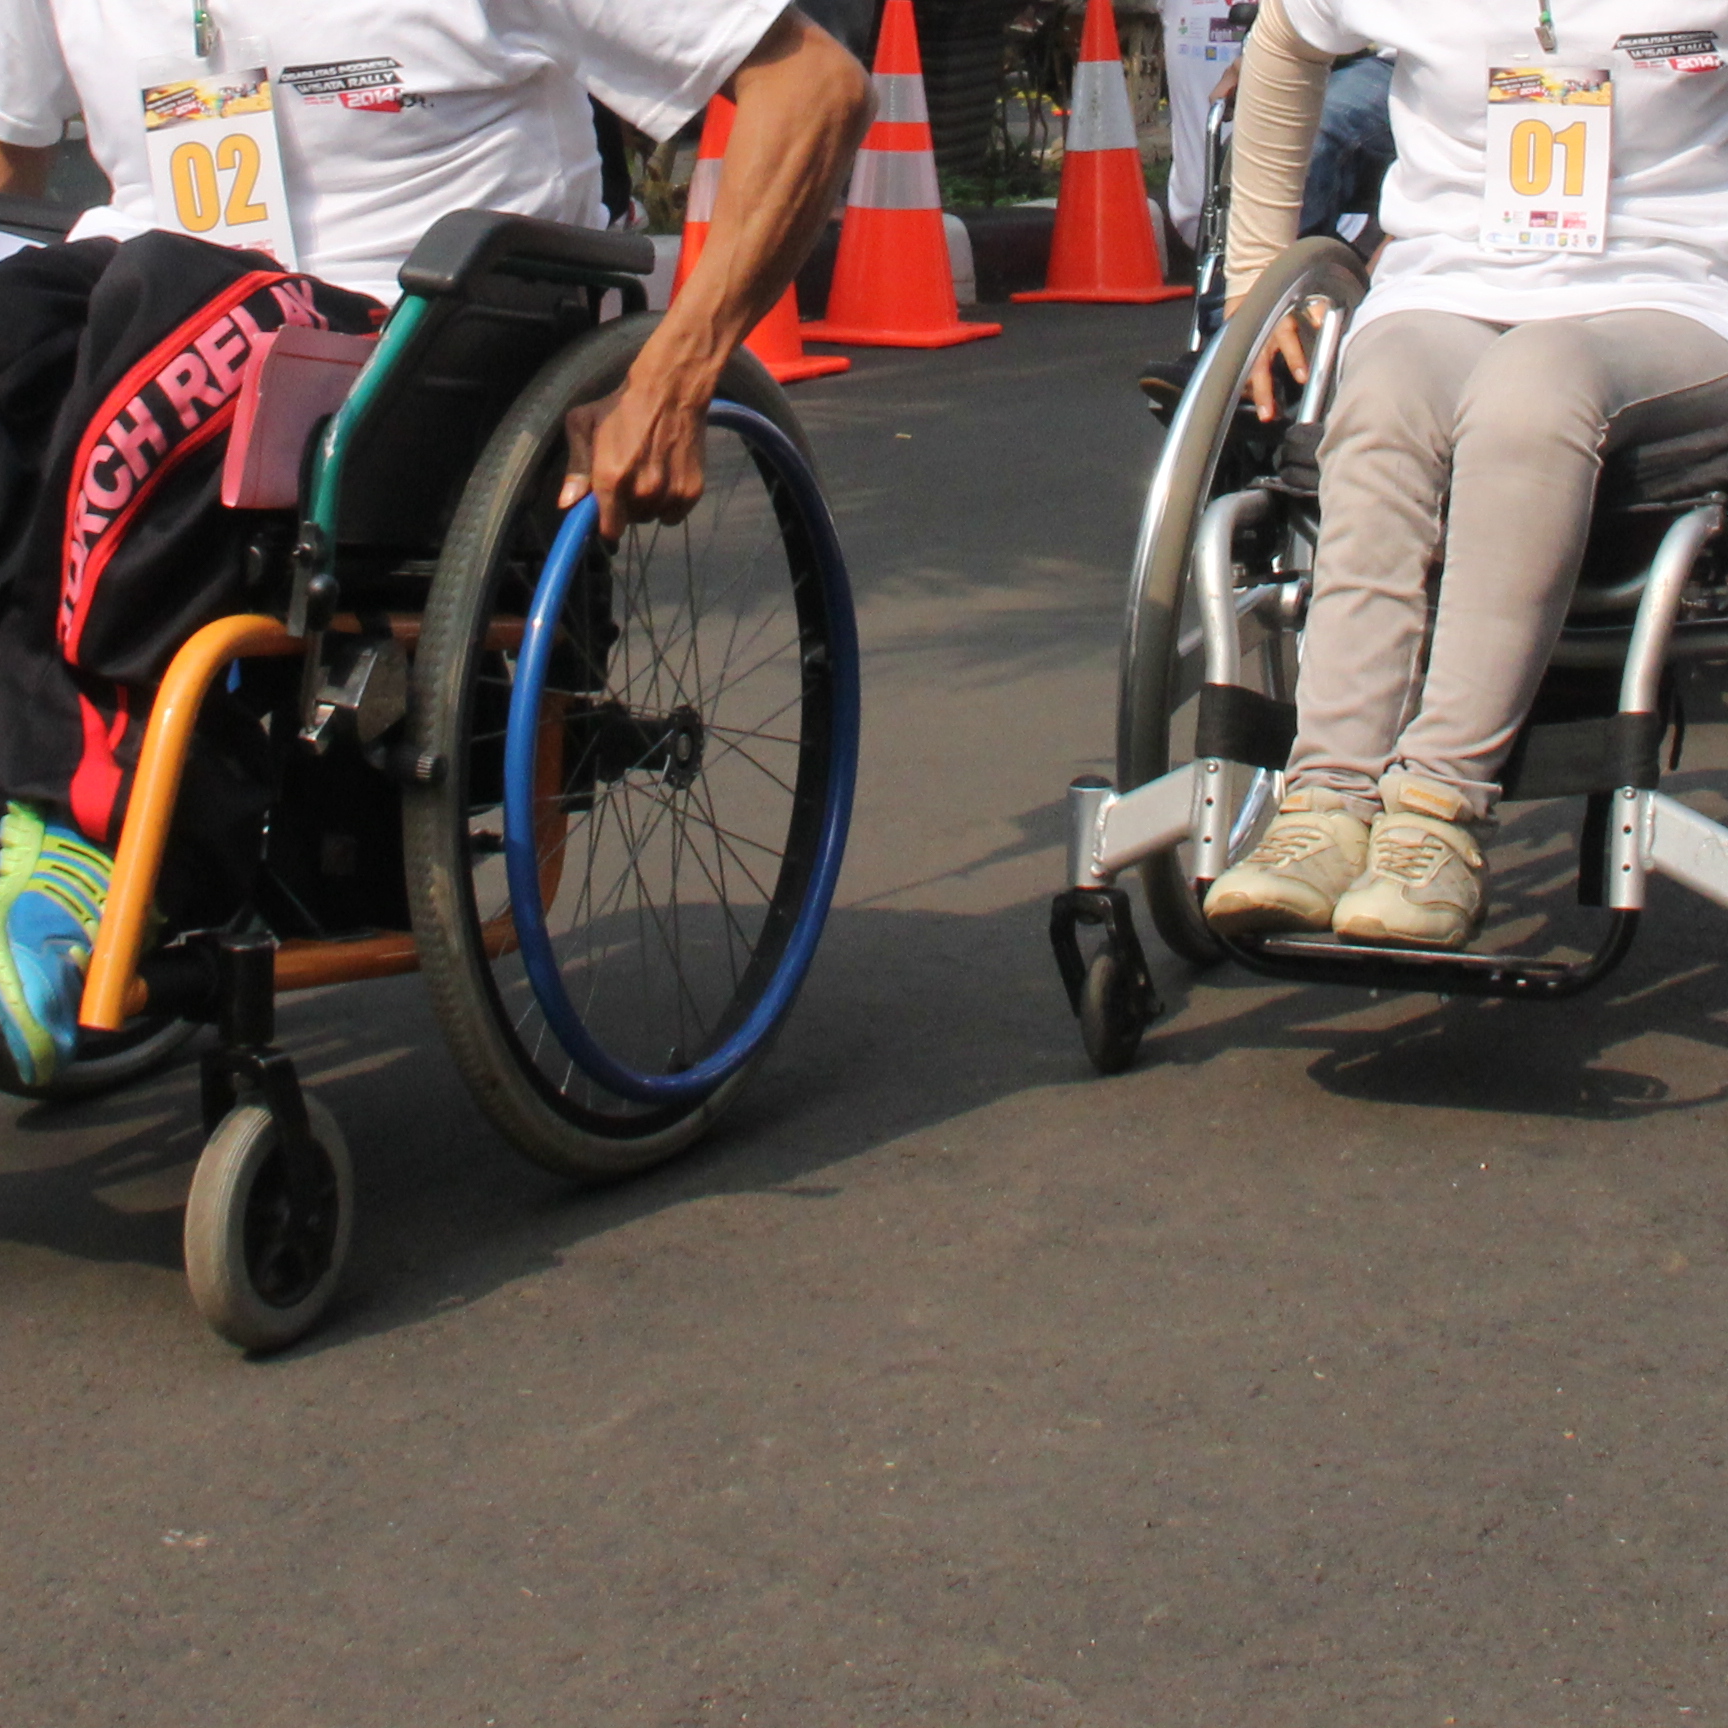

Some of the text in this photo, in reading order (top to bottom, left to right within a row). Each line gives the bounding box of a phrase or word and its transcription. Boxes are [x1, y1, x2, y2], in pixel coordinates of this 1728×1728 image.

[1677, 41, 1712, 53] RALLY
[1675, 55, 1714, 70] 2014
[297, 72, 394, 94] WISATA RALLY
[347, 89, 395, 108] 2014
[1509, 118, 1587, 196] 01
[170, 133, 268, 233] 02
